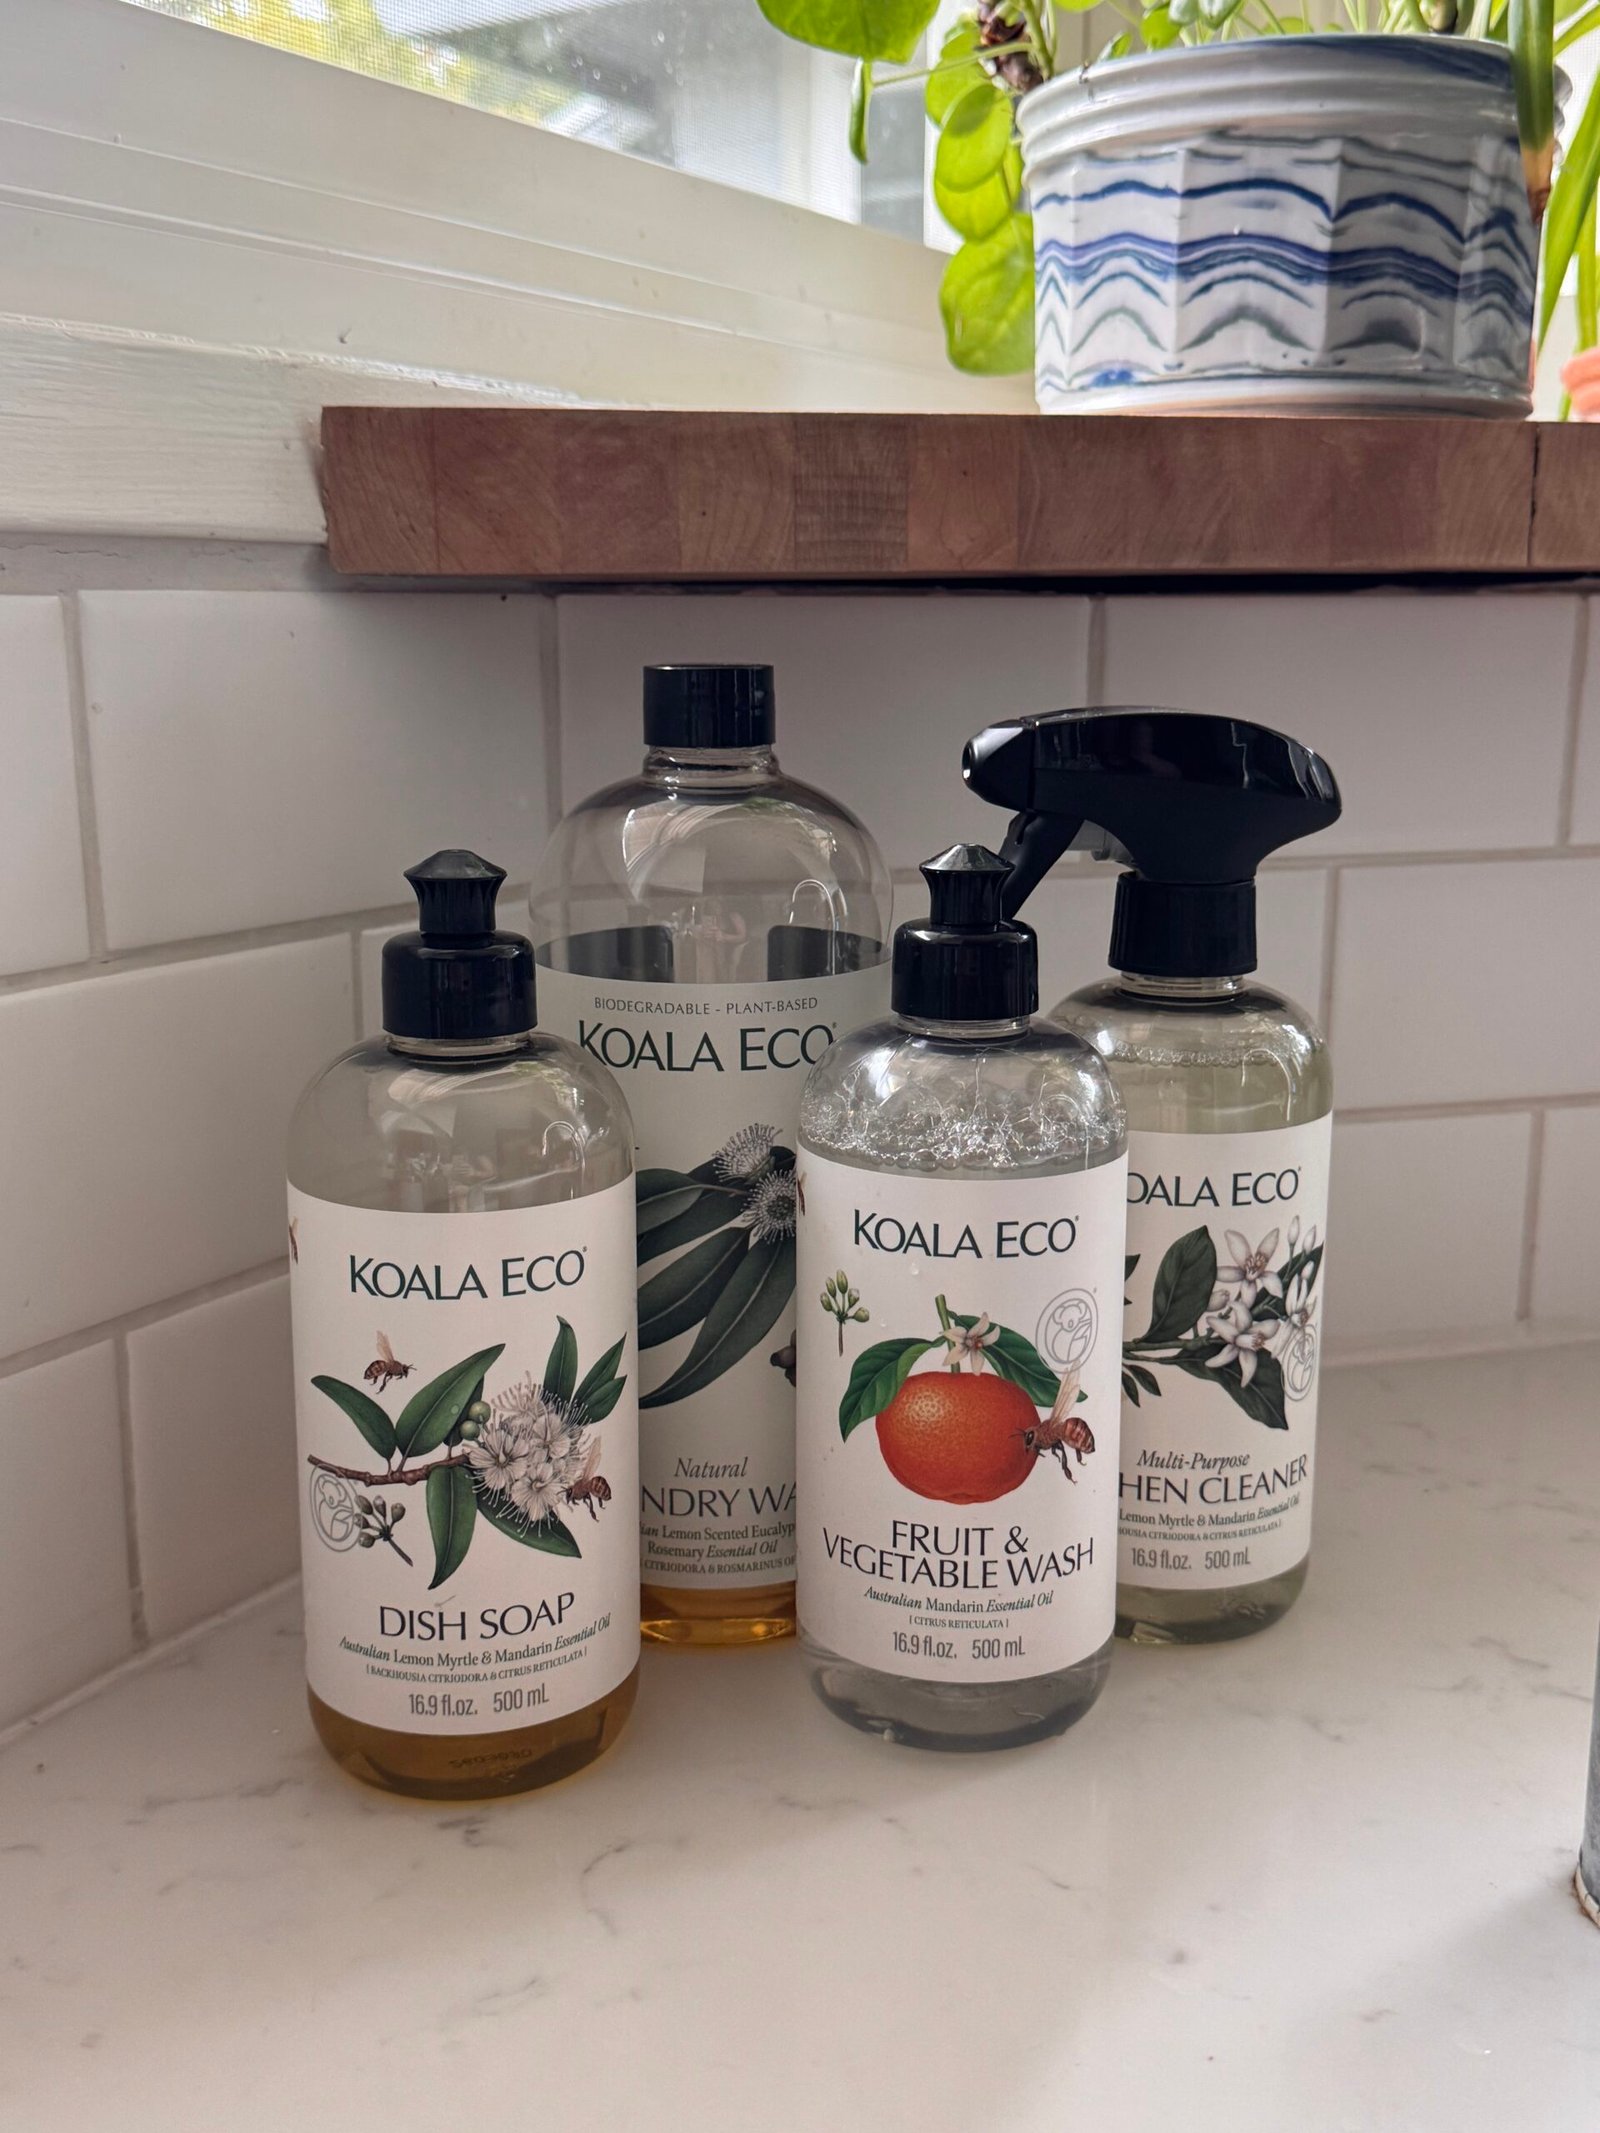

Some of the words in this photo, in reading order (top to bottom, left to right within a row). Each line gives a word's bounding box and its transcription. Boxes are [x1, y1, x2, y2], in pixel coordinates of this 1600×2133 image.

[594, 996, 711, 1015] BIODEGRADABLE
[726, 996, 818, 1015] PLANT-BASED
[578, 1019, 725, 1072] KOALA
[739, 1023, 834, 1071] ECO
[1231, 1167, 1299, 1206] ECO
[854, 1208, 983, 1259] KOALA
[996, 1217, 1077, 1258] ECO
[349, 1254, 489, 1301] KOALA
[502, 1249, 586, 1297] ECO
[674, 1456, 749, 1479] Natural
[1136, 1449, 1250, 1475] Multi-Purpose
[1199, 1453, 1307, 1504] CLEANER
[662, 1525, 702, 1540] Lemon
[704, 1524, 749, 1541] Scented
[1119, 1507, 1156, 1525] Lemon
[1158, 1511, 1195, 1530] Myrtle
[1196, 1513, 1206, 1527] &
[1207, 1511, 1256, 1527] Mandarin
[647, 1541, 706, 1562] Rosemary
[706, 1541, 758, 1559] Essential
[759, 1539, 778, 1555] Oil
[892, 1519, 995, 1556] FRUIT
[1003, 1525, 1029, 1555] &
[644, 1559, 706, 1574] CITRIODORA
[716, 1559, 782, 1574] ROSMARINUS
[822, 1526, 999, 1589] VEGETABLE
[1007, 1536, 1094, 1587] WASH
[1131, 1547, 1158, 1568] 16.9
[1205, 1549, 1230, 1570] 500
[1232, 1546, 1251, 1567] mL
[863, 1585, 922, 1610] Australian
[925, 1597, 984, 1613] Mandarin
[985, 1594, 1036, 1613] Essential
[1037, 1590, 1054, 1607] Oil
[380, 1605, 467, 1641] DISH
[480, 1591, 575, 1640] SOAP
[339, 1635, 390, 1662] Australian
[394, 1649, 434, 1667] Lemon
[437, 1651, 479, 1672] Myrtle
[481, 1650, 492, 1665] &
[495, 1642, 553, 1664] Mandarin
[554, 1620, 598, 1651] Essential
[597, 1612, 611, 1633] Oil
[893, 1631, 920, 1655] 16.9
[972, 1638, 1001, 1660] 500
[1004, 1635, 1026, 1657] mL
[428, 1673, 489, 1684] CITRIODORA
[498, 1666, 532, 1679] CITRUS
[408, 1693, 438, 1717] 16.9
[493, 1687, 523, 1713] 500
[527, 1682, 550, 1707] mL
